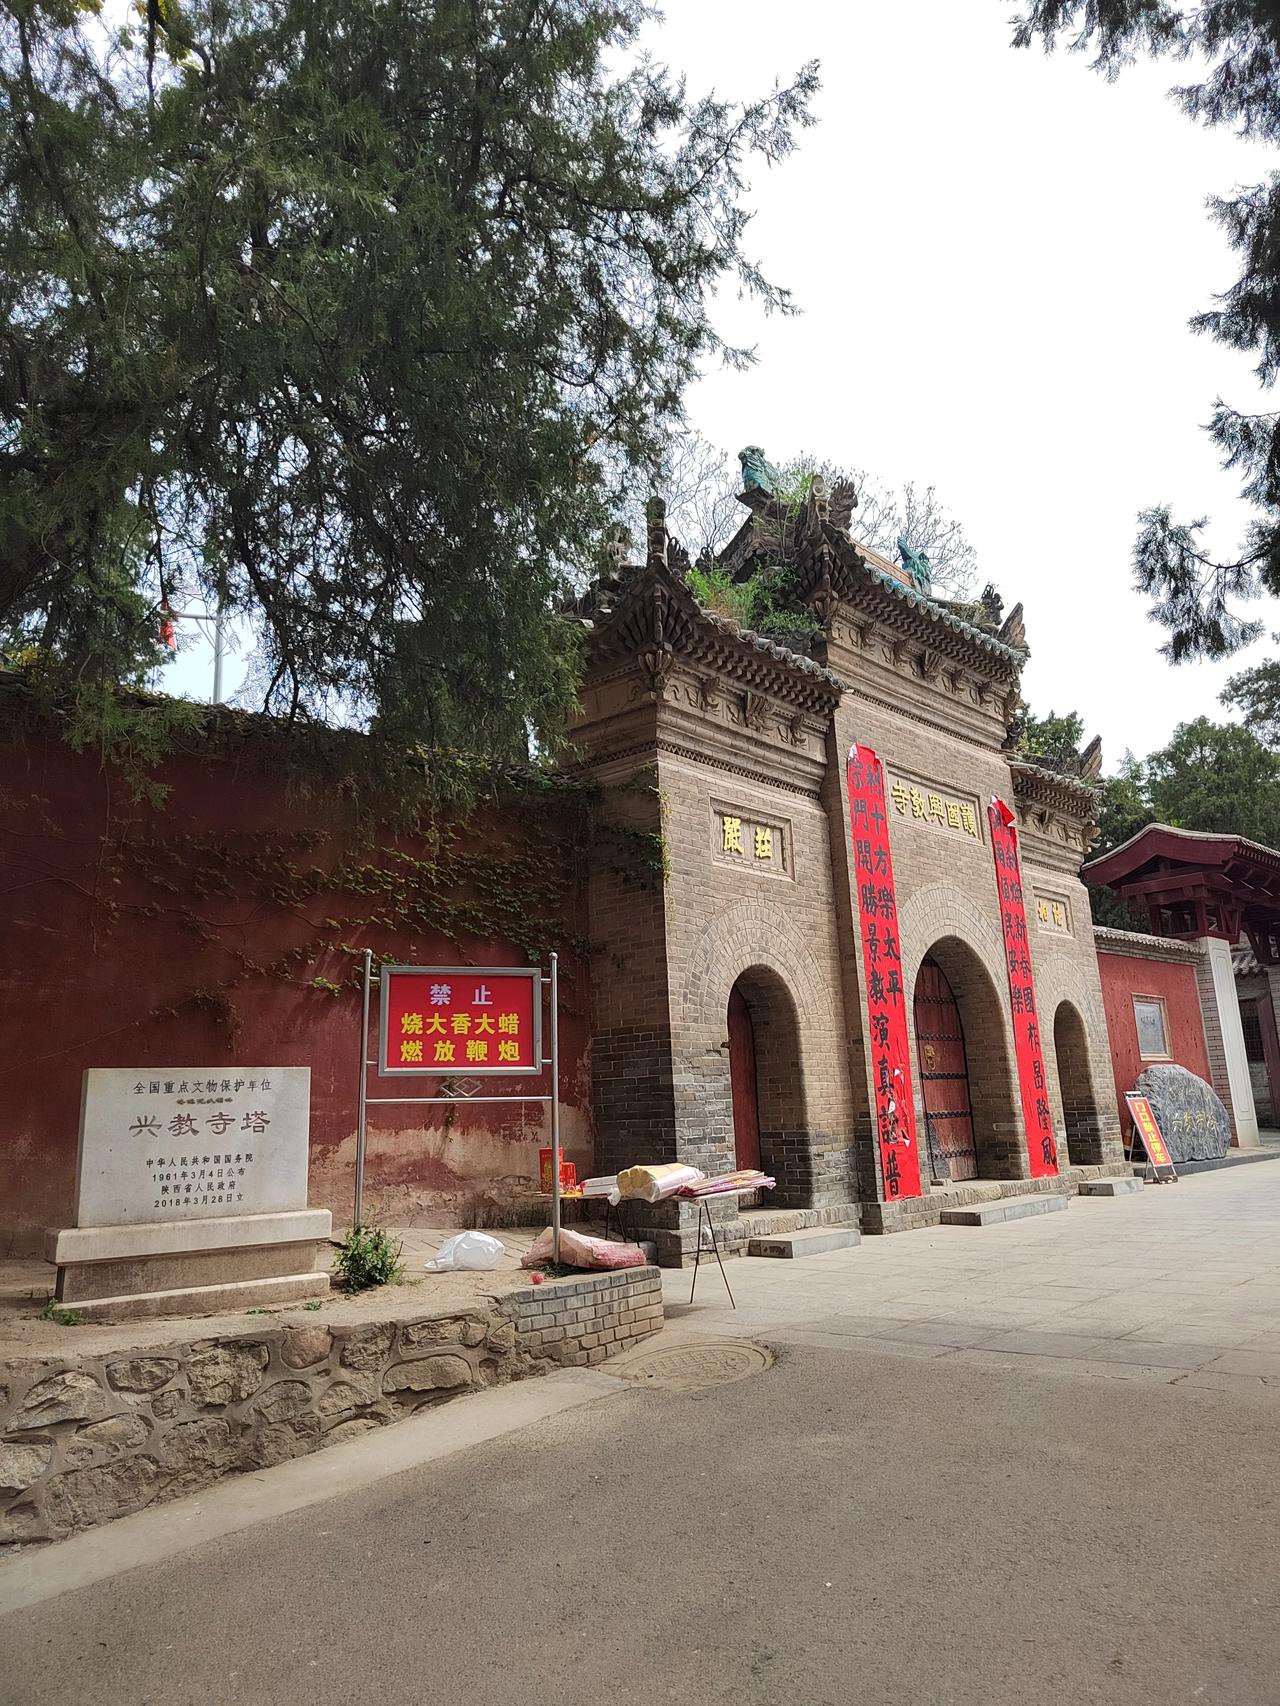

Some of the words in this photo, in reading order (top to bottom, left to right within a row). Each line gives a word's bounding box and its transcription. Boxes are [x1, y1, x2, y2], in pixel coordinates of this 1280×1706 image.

[430, 983, 493, 1006] 禁止
[400, 1012, 520, 1035] 烧大香大蜡
[400, 1039, 520, 1062] 燃放鞭炮
[133, 1077, 272, 1095] 全国重点文物保护单位
[128, 1110, 271, 1138] 兴教寺塔
[1134, 1101, 1166, 1163] 门口禁止停车
[146, 1153, 254, 1168] 中华人民共和国国务院
[152, 1167, 246, 1182] 1961年3月4日公布
[161, 1180, 237, 1195] 陕西省人民政府
[154, 1193, 244, 1208] 2018年3月28日立
